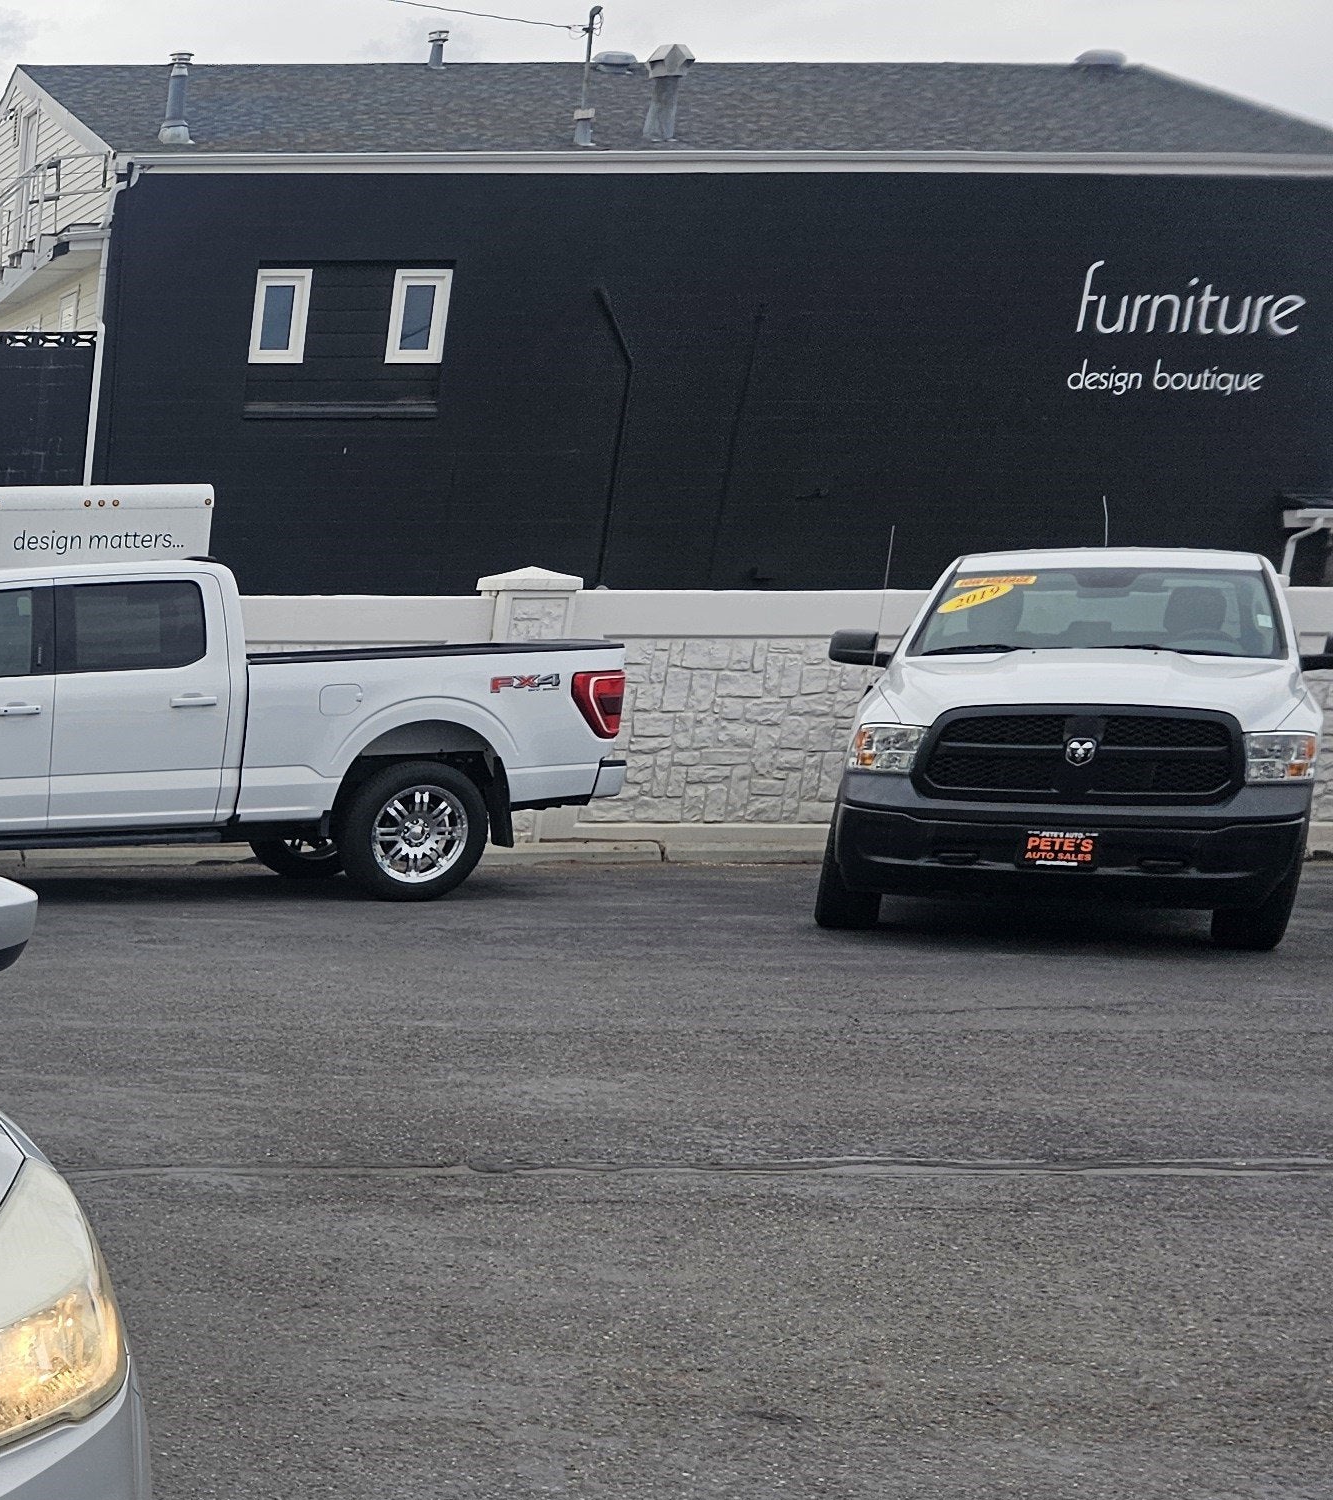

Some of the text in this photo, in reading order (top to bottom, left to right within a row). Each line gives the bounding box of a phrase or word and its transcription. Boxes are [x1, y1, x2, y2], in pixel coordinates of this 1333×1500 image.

[1075, 260, 1306, 335] furniture
[1067, 358, 1264, 396] design boutique
[13, 530, 185, 554] design matters...
[956, 586, 1000, 608] 2019
[490, 673, 560, 693] FX4
[1027, 836, 1094, 852] PETE'S
[1024, 851, 1092, 861] AUTO SALES
